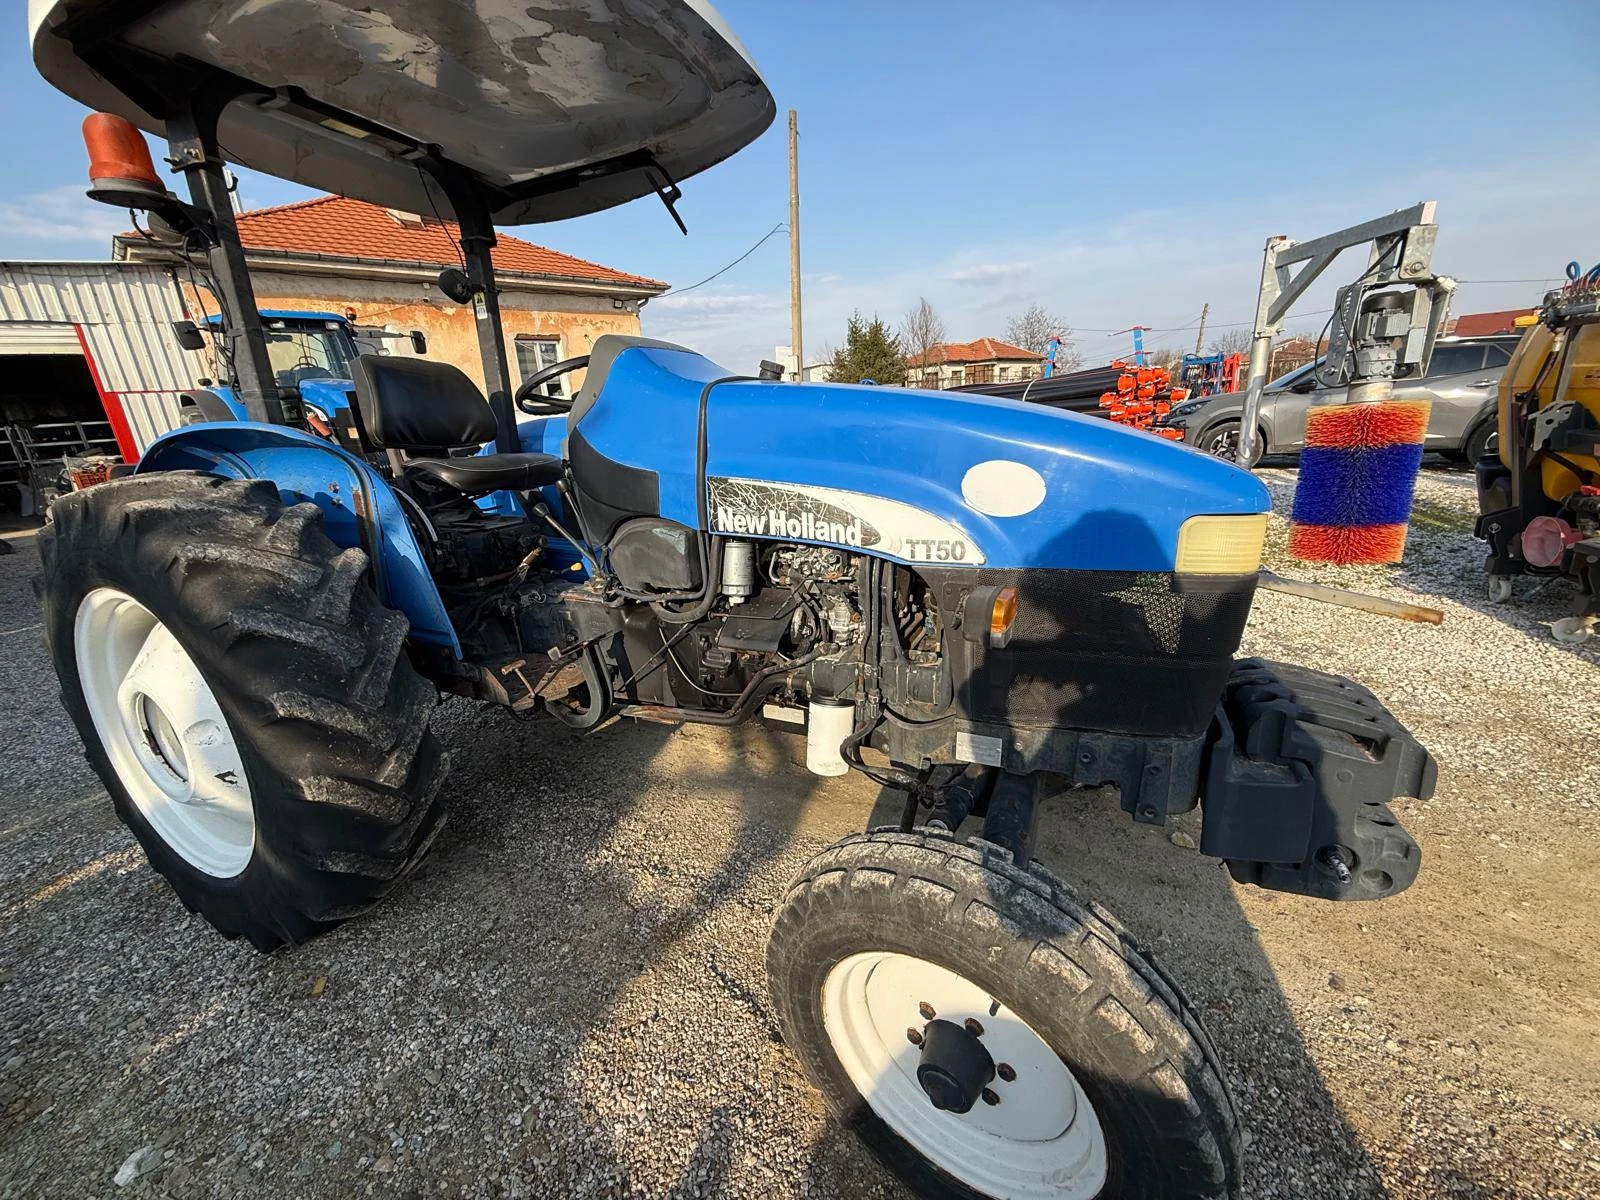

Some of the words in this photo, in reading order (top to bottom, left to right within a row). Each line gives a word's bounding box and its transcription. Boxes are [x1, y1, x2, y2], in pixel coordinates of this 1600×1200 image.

[717, 507, 766, 534] New
[769, 509, 862, 546] Holland
[905, 538, 967, 561] TT50
